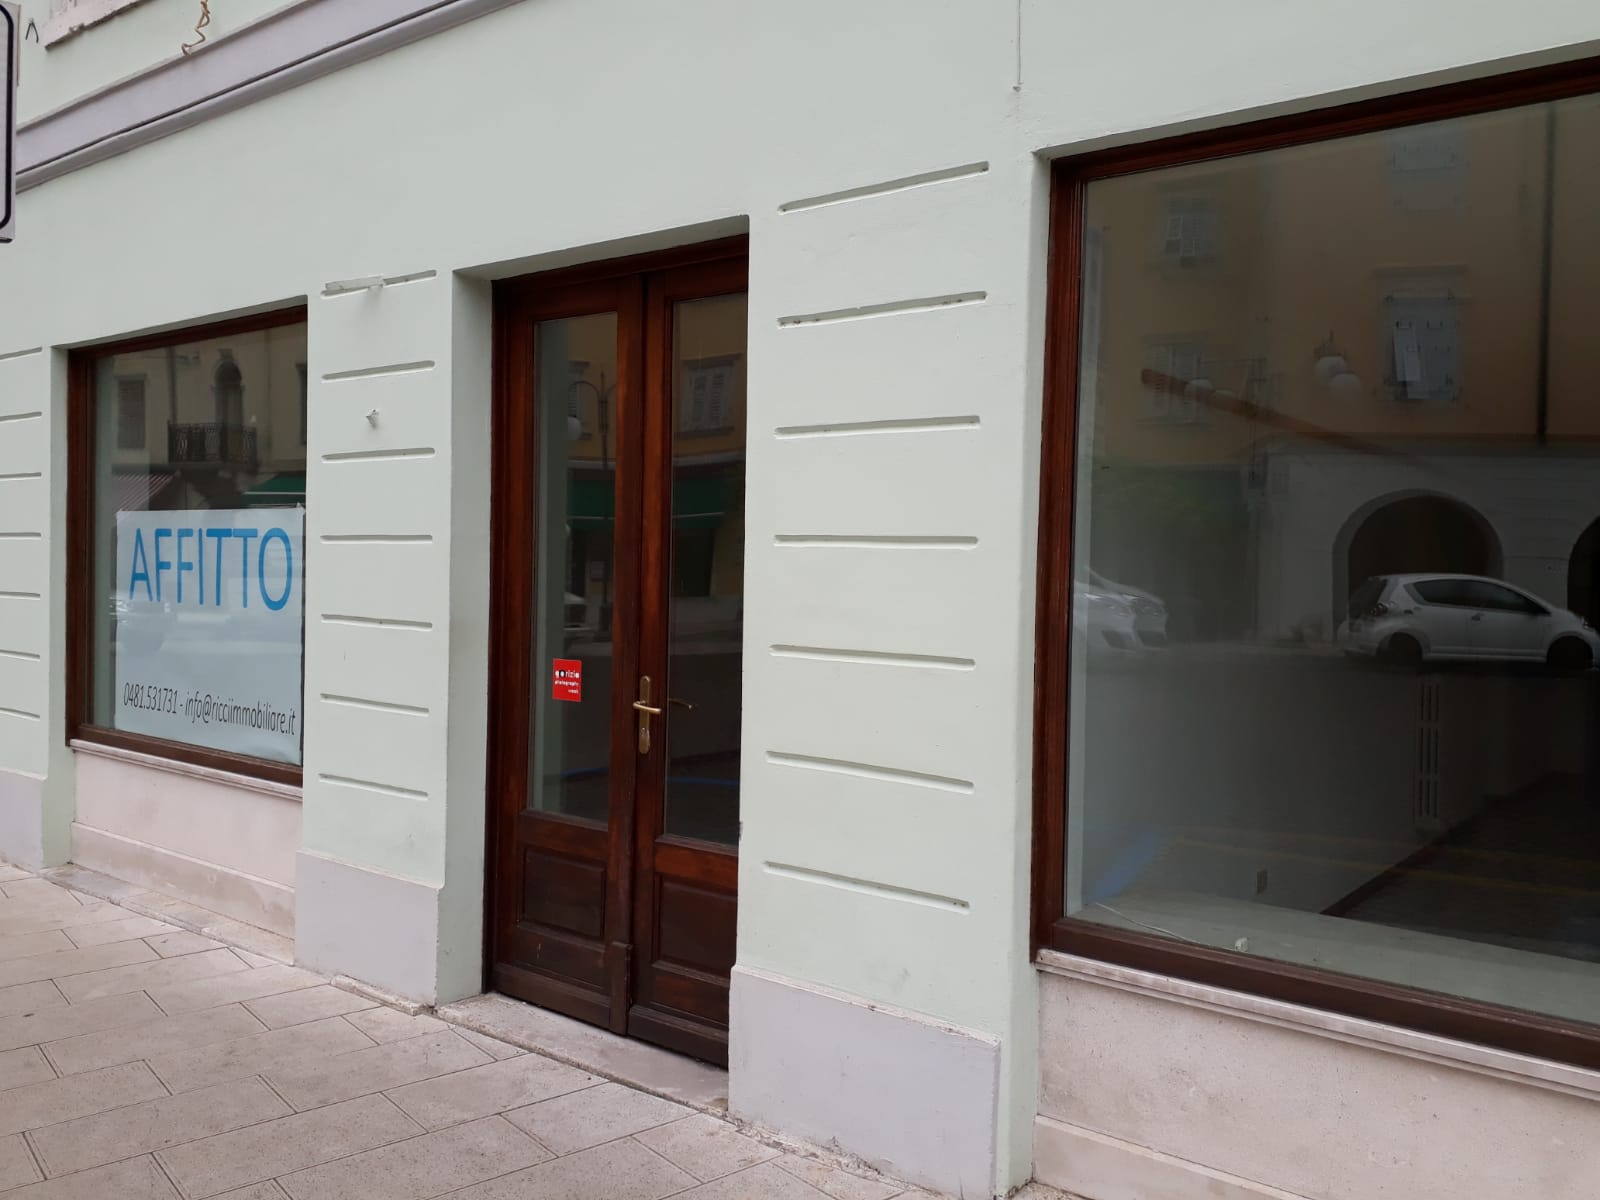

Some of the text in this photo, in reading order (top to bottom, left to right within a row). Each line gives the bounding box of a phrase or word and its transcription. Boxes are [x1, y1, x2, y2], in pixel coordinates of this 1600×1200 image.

[130, 527, 292, 611] AFFITTO
[123, 682, 179, 714] 0481.531731
[185, 691, 296, 735] info@ricciimmobiliare.it
